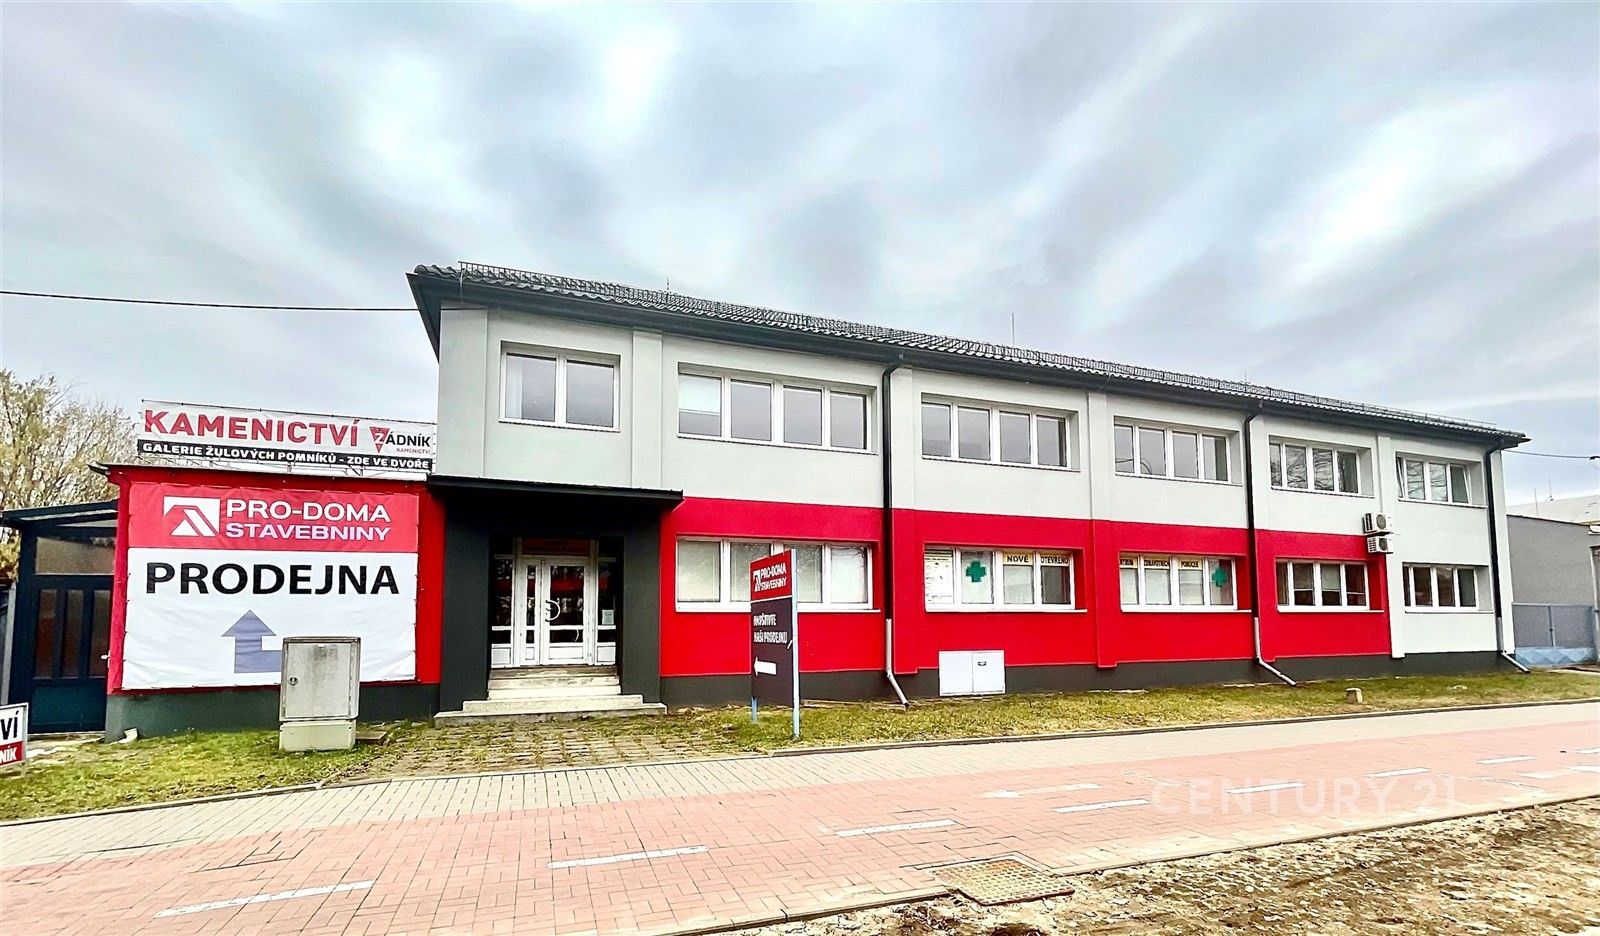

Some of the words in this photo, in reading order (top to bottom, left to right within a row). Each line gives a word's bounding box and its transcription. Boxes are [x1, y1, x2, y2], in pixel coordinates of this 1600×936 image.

[144, 409, 359, 447] KAMENICTVÍ
[143, 443, 202, 455] GALERIE
[205, 445, 275, 460] ŽULOVÝCH
[278, 451, 336, 463] POMNÍKŮ
[346, 456, 370, 466] ZDE
[373, 458, 388, 466] VE
[390, 458, 430, 469] DVOŘE
[226, 498, 392, 523] PRO-DOMA
[225, 523, 391, 542] STAVEBNINY
[145, 562, 400, 595] PRODEJNA
[760, 562, 787, 578] PRO-DOMA
